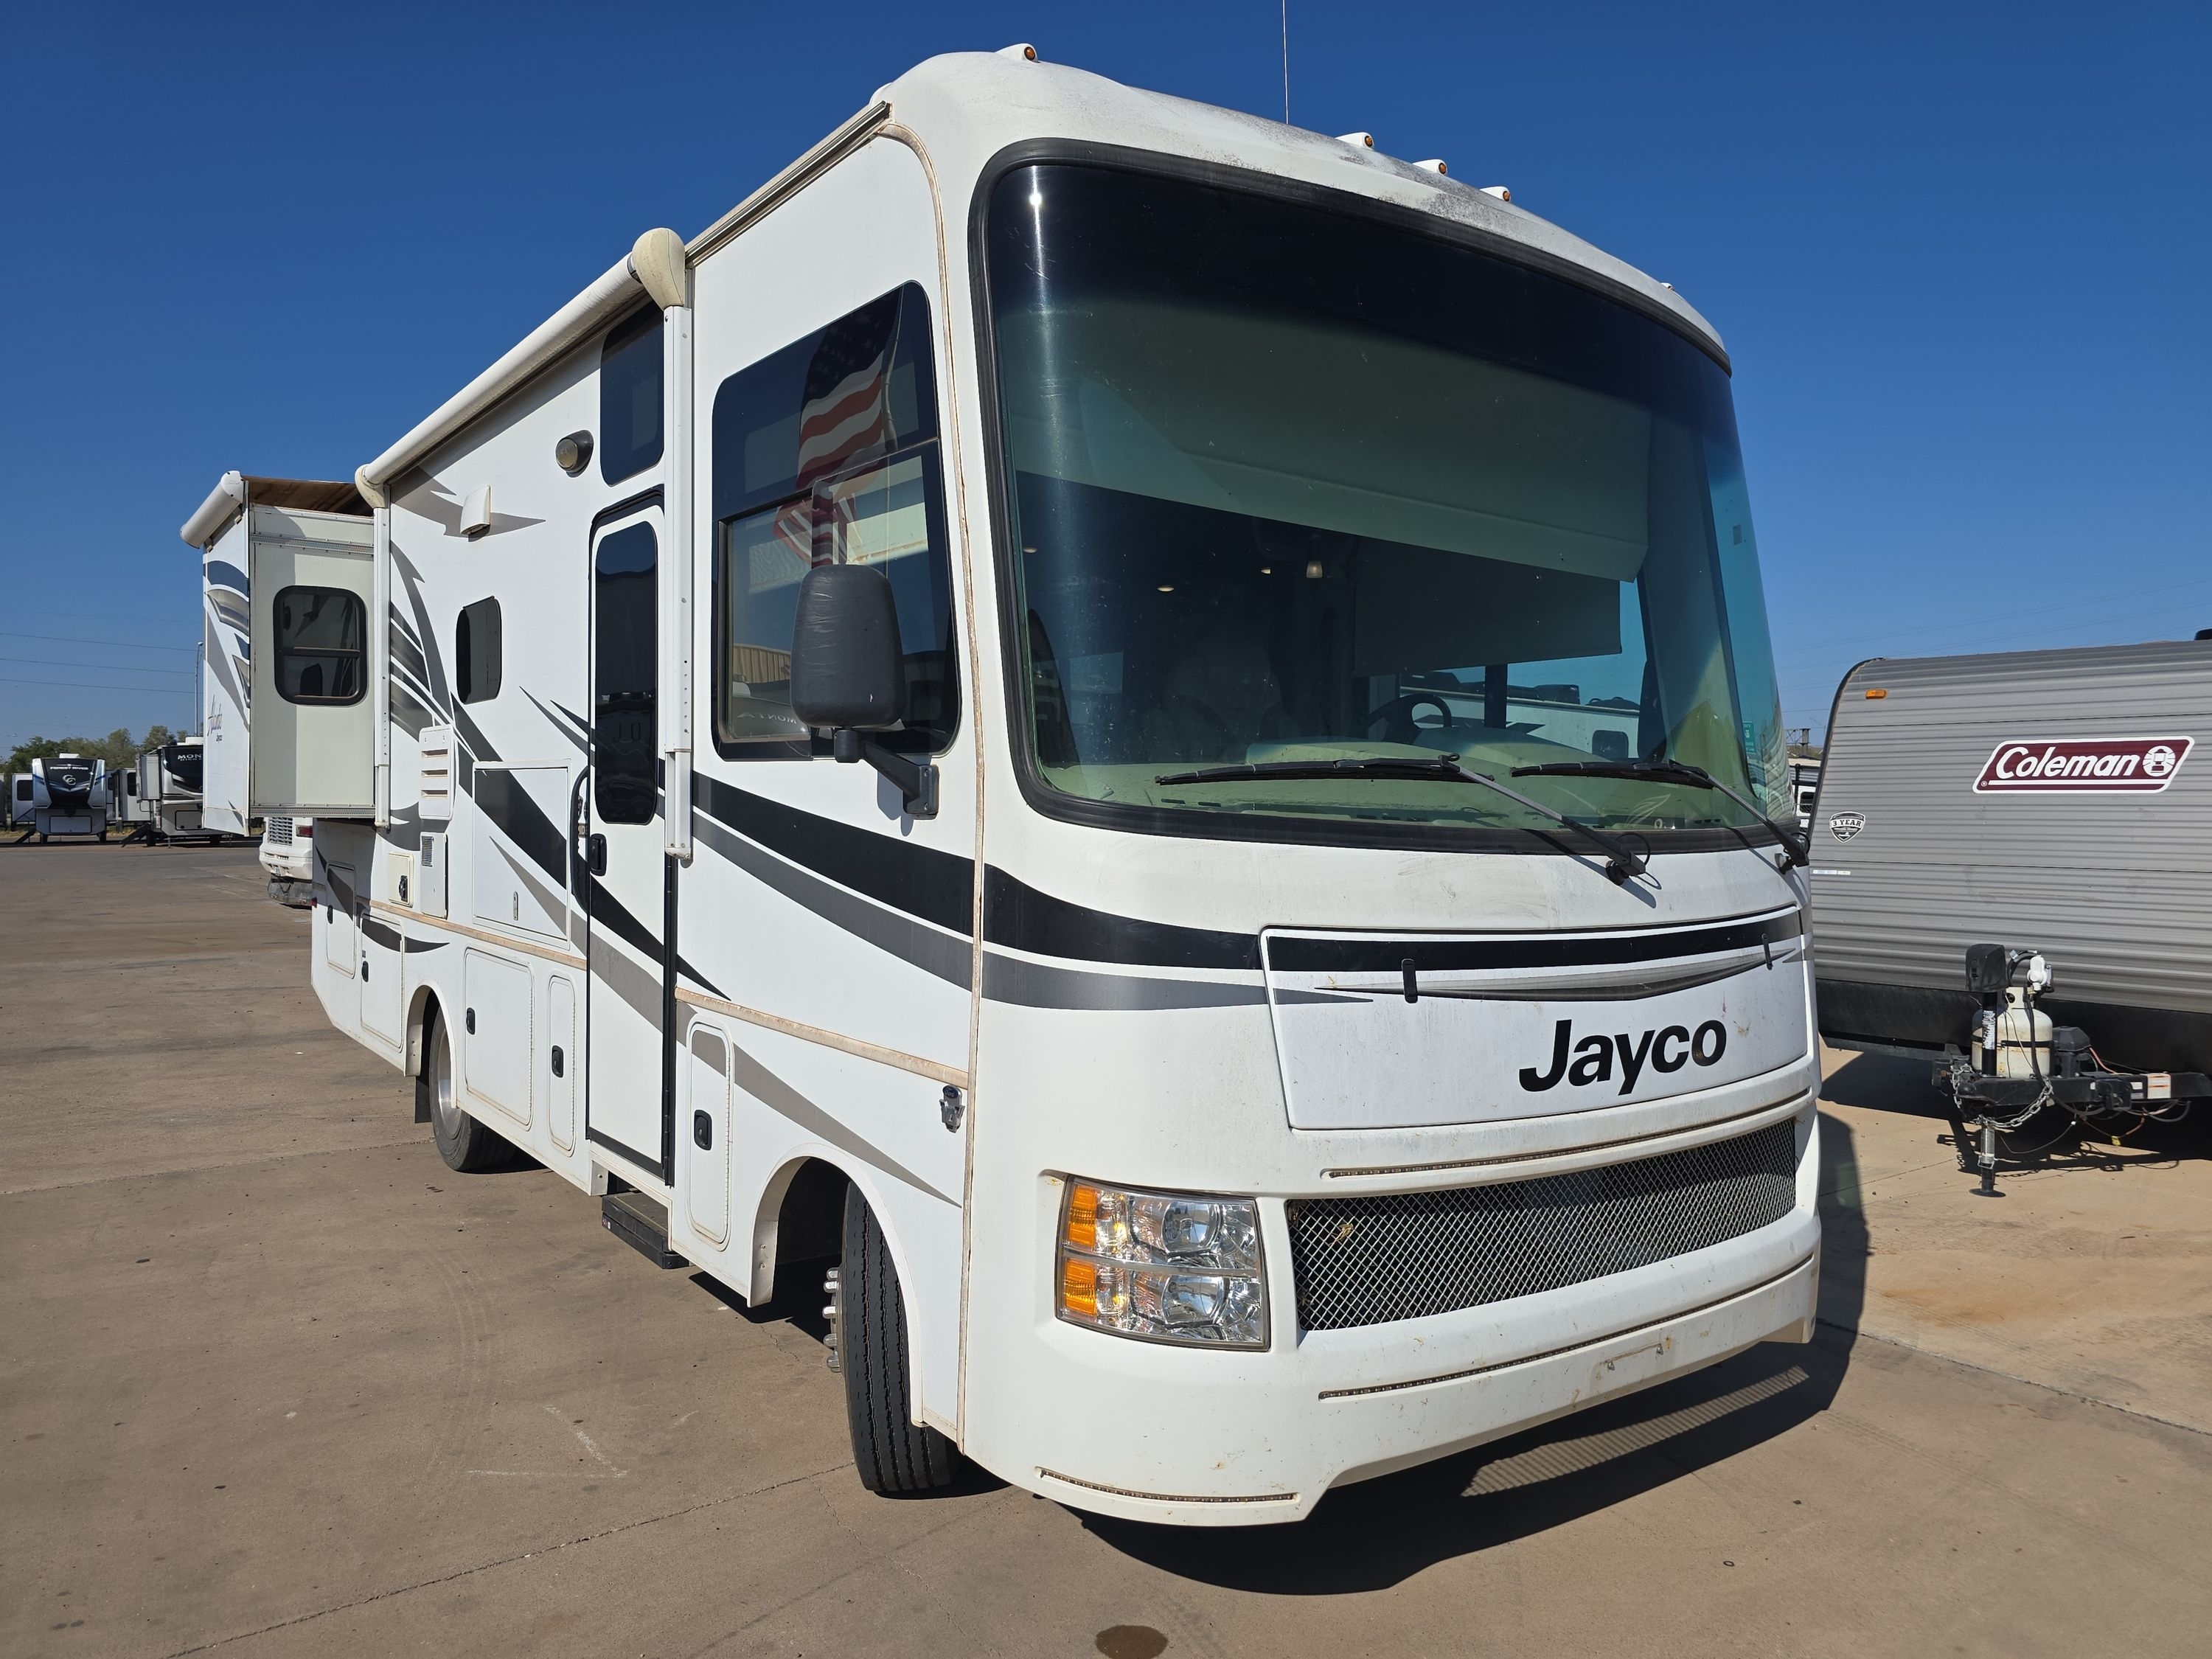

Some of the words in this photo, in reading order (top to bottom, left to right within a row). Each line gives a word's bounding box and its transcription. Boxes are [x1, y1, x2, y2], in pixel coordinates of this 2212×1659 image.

[1995, 746, 2140, 779] Coleman
[1840, 819, 1862, 827] YEAR
[1519, 1019, 1727, 1096] Jayco
